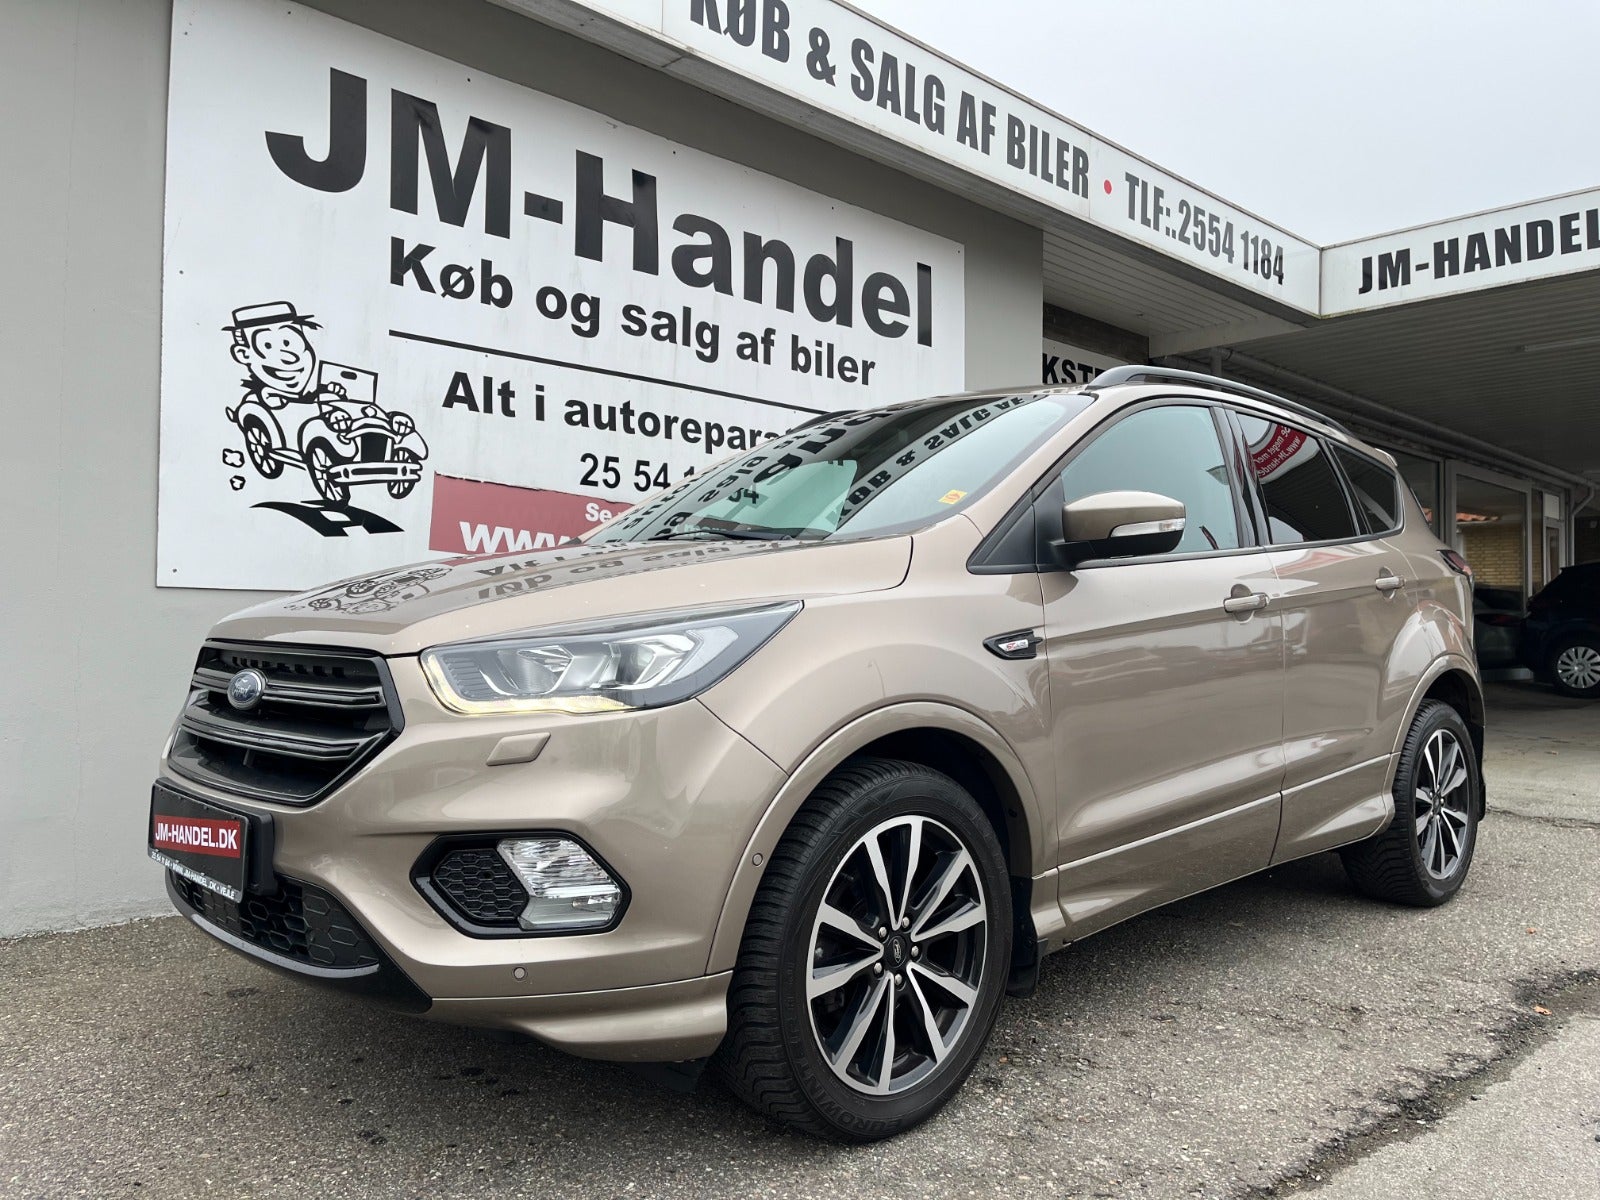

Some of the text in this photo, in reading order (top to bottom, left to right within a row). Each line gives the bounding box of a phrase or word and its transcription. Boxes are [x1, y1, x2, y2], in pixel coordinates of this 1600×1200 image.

[806, 27, 836, 87] &
[851, 38, 945, 136] SALG
[956, 90, 997, 156] AF
[1007, 113, 1089, 199] BILER
[1240, 230, 1284, 286] 1184
[264, 67, 933, 347] JM-Handel
[1358, 208, 1600, 295] JM-HANDEL
[389, 237, 876, 386] Køb og salg af biler
[442, 371, 516, 418] Alt
[535, 385, 545, 421] i
[580, 453, 621, 489] 25
[634, 459, 671, 492] 54
[584, 503, 613, 523] Se
[155, 822, 238, 850] JM-HANDEL.DK
